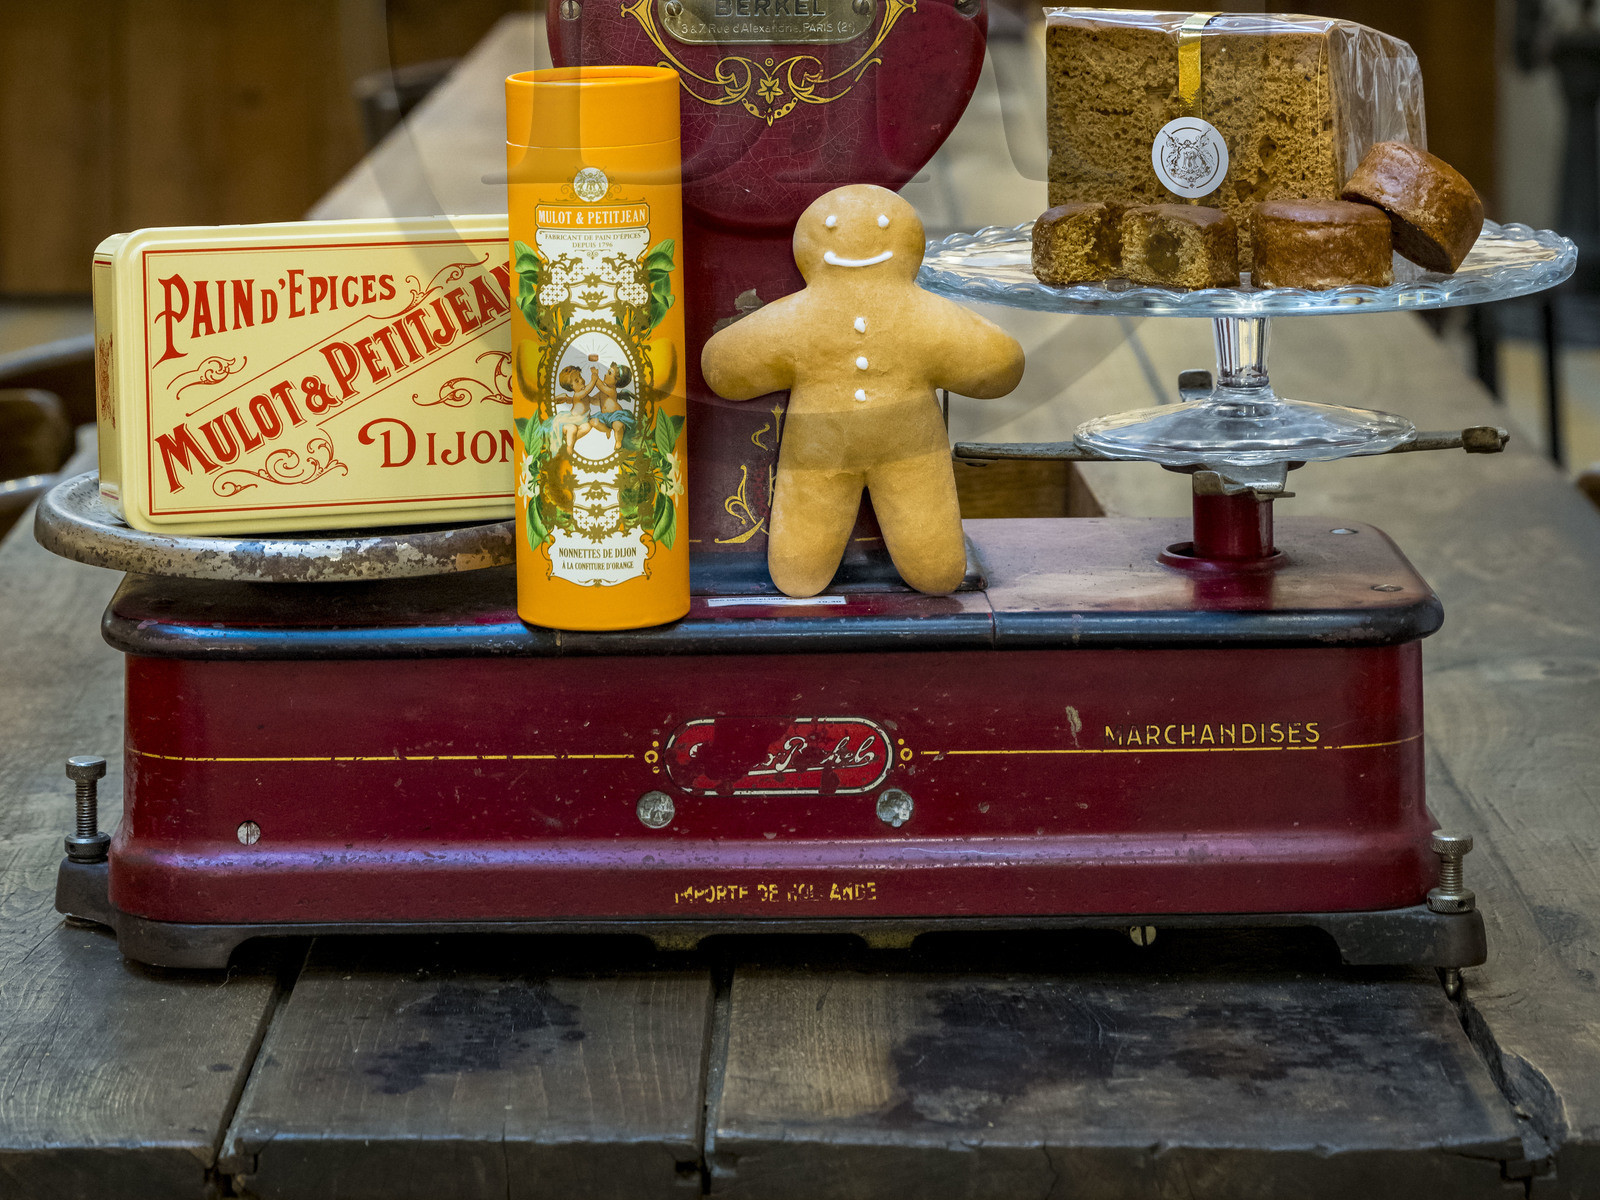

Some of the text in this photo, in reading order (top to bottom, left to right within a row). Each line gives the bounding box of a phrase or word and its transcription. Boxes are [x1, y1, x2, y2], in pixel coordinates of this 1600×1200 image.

[709, 23, 730, 33] Rue
[538, 208, 646, 224] MULOT & PETITJEAN
[545, 233, 583, 241] FABRICANT
[572, 241, 597, 249] DEPUIS
[152, 273, 255, 369] PAIN
[558, 547, 637, 559] NONNETTES DE DIJON
[566, 562, 574, 570] LA
[574, 562, 605, 570] CONFITURE
[606, 561, 634, 570] D'ORANGE
[1104, 722, 1320, 746] MARCHANDISES
